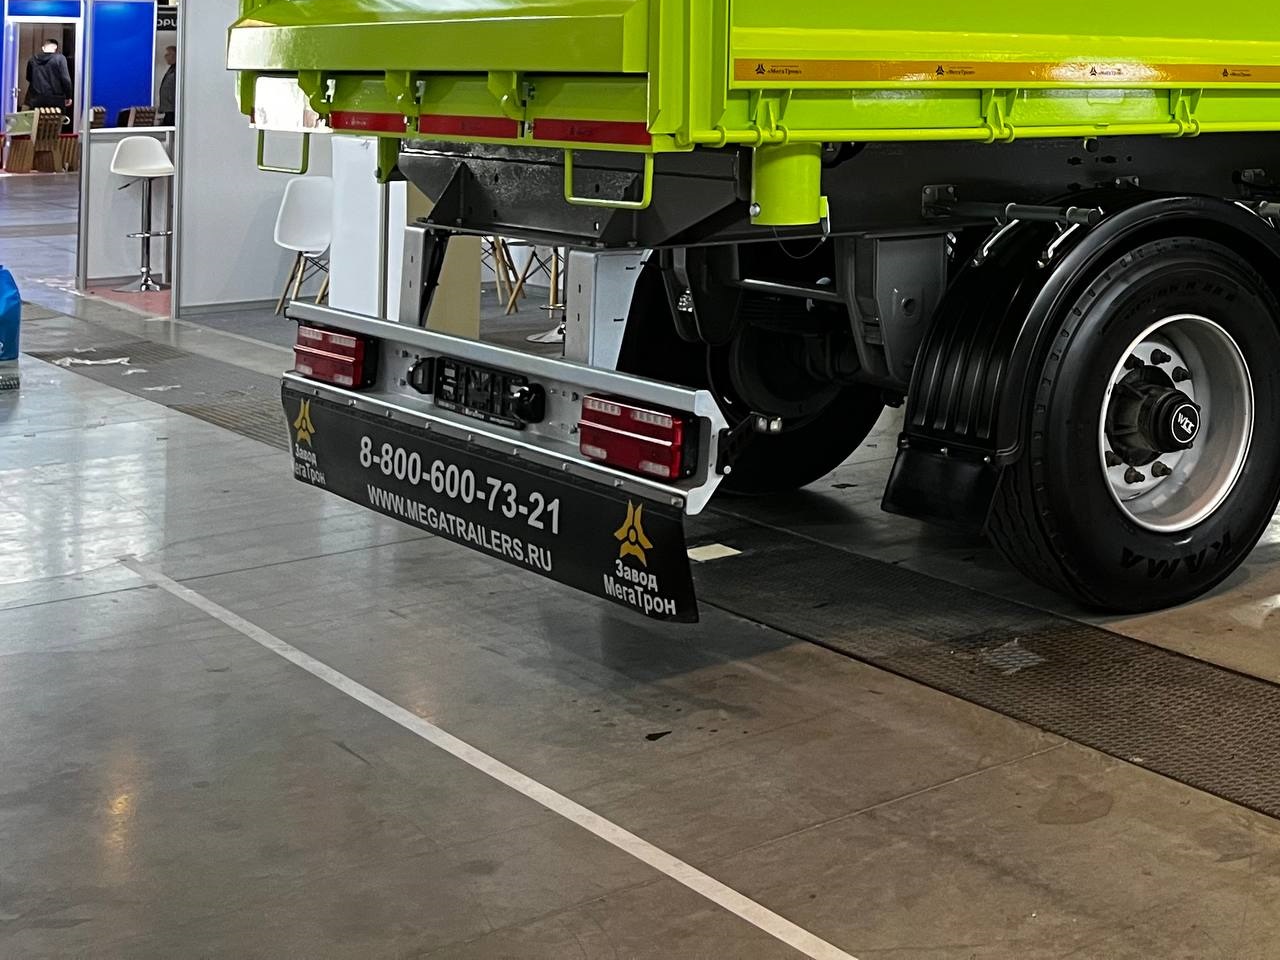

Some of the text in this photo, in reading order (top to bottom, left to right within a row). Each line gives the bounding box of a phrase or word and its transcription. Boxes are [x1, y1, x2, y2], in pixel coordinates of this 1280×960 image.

[295, 442, 318, 467] Завод
[295, 462, 326, 485] егаТрон
[360, 436, 560, 535] 8-800-600-73-21
[367, 484, 552, 571] WWW.MEGATRAILERS.RU
[615, 559, 658, 592] Завод
[603, 574, 676, 615] МегаТрон
